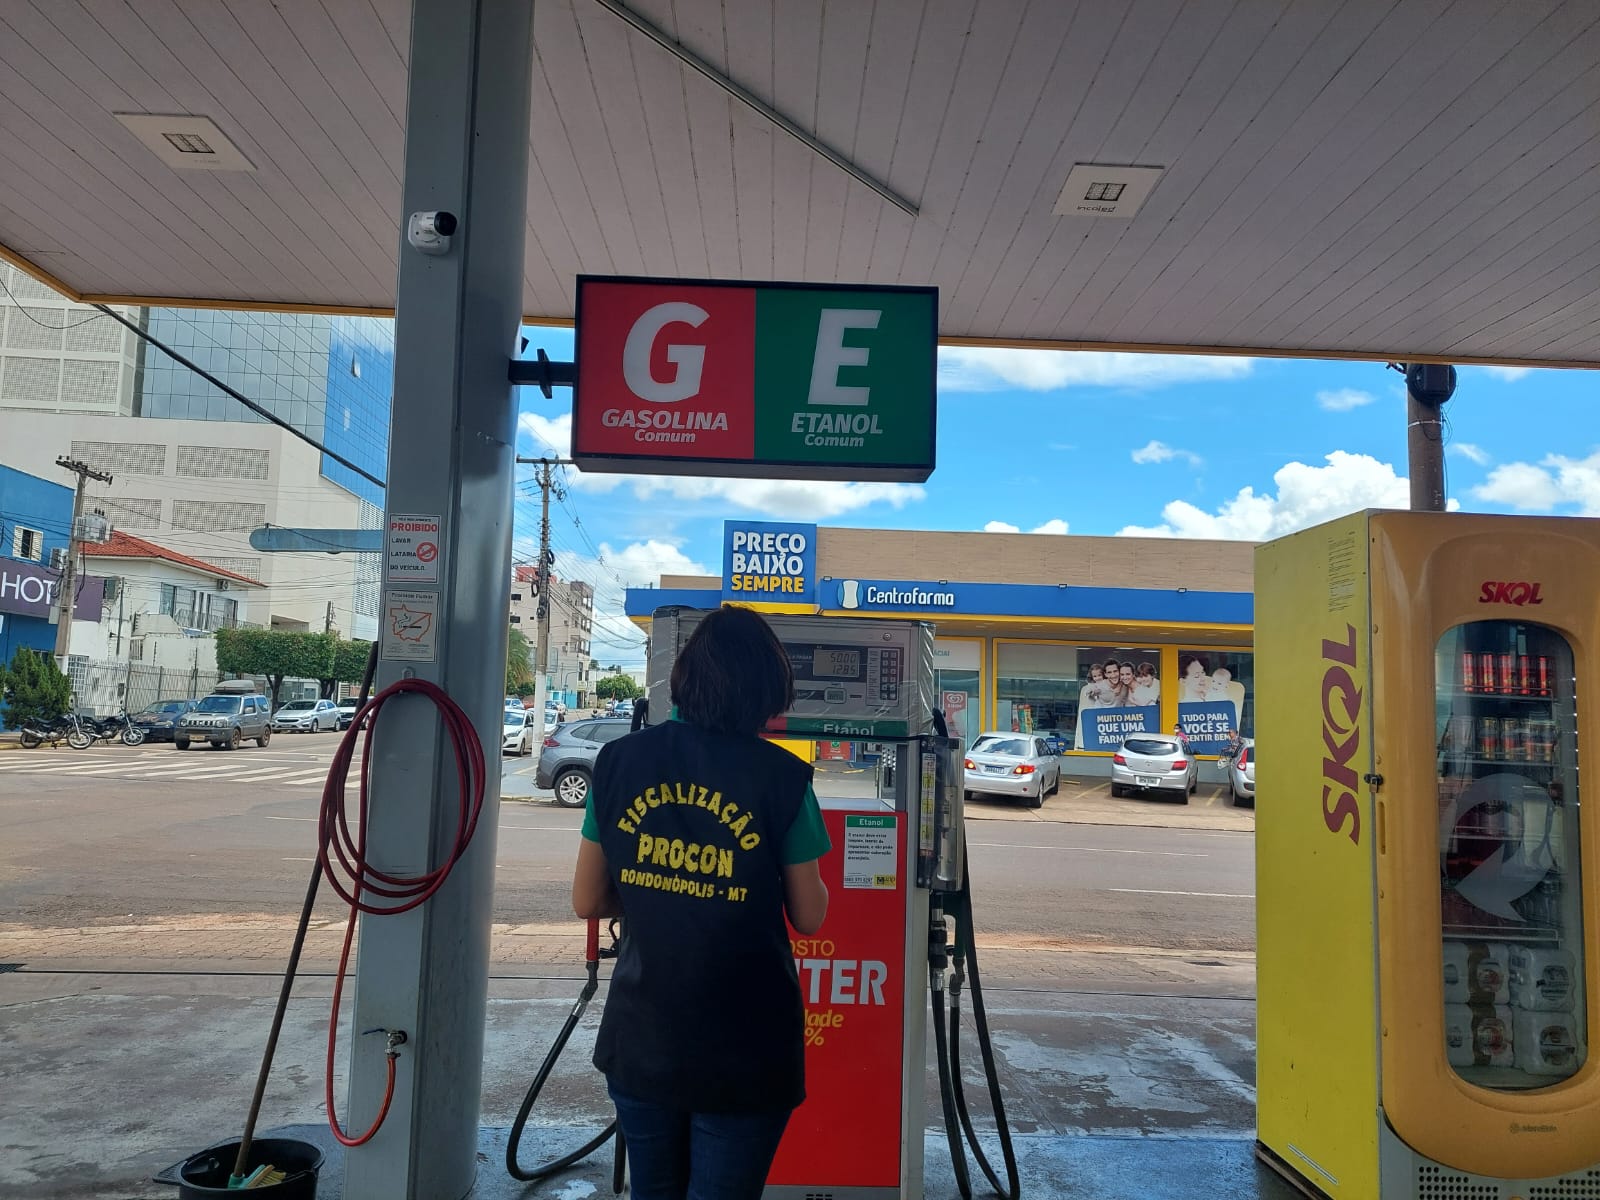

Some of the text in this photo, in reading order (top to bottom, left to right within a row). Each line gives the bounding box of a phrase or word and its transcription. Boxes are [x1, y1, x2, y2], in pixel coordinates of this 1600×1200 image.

[623, 302, 710, 402] G
[808, 308, 882, 406] E
[602, 409, 728, 430] GASOLINA
[791, 412, 883, 434] ETANOL
[634, 429, 696, 443] Comum
[804, 433, 864, 447] Comum
[391, 522, 438, 532] PROIBIDO
[733, 531, 806, 559] PREÇO
[732, 552, 804, 575] BAIXO
[1, 571, 77, 608] HOT
[731, 574, 805, 593] SEMPRE
[867, 586, 955, 606] Centrofarma
[1096, 713, 1144, 723] MUITO MAIS
[1182, 713, 1229, 722] TUDO PARA
[1183, 721, 1230, 734] VOCÊ SE
[823, 723, 875, 736] Etanol
[1097, 722, 1146, 735] QUE UMA
[617, 783, 760, 850] FISCALIZAÇÃO
[859, 818, 884, 826] Etanol
[637, 833, 733, 878] PROCON
[621, 869, 715, 898] RONDONÓPOLIS
[728, 887, 748, 902] MT
